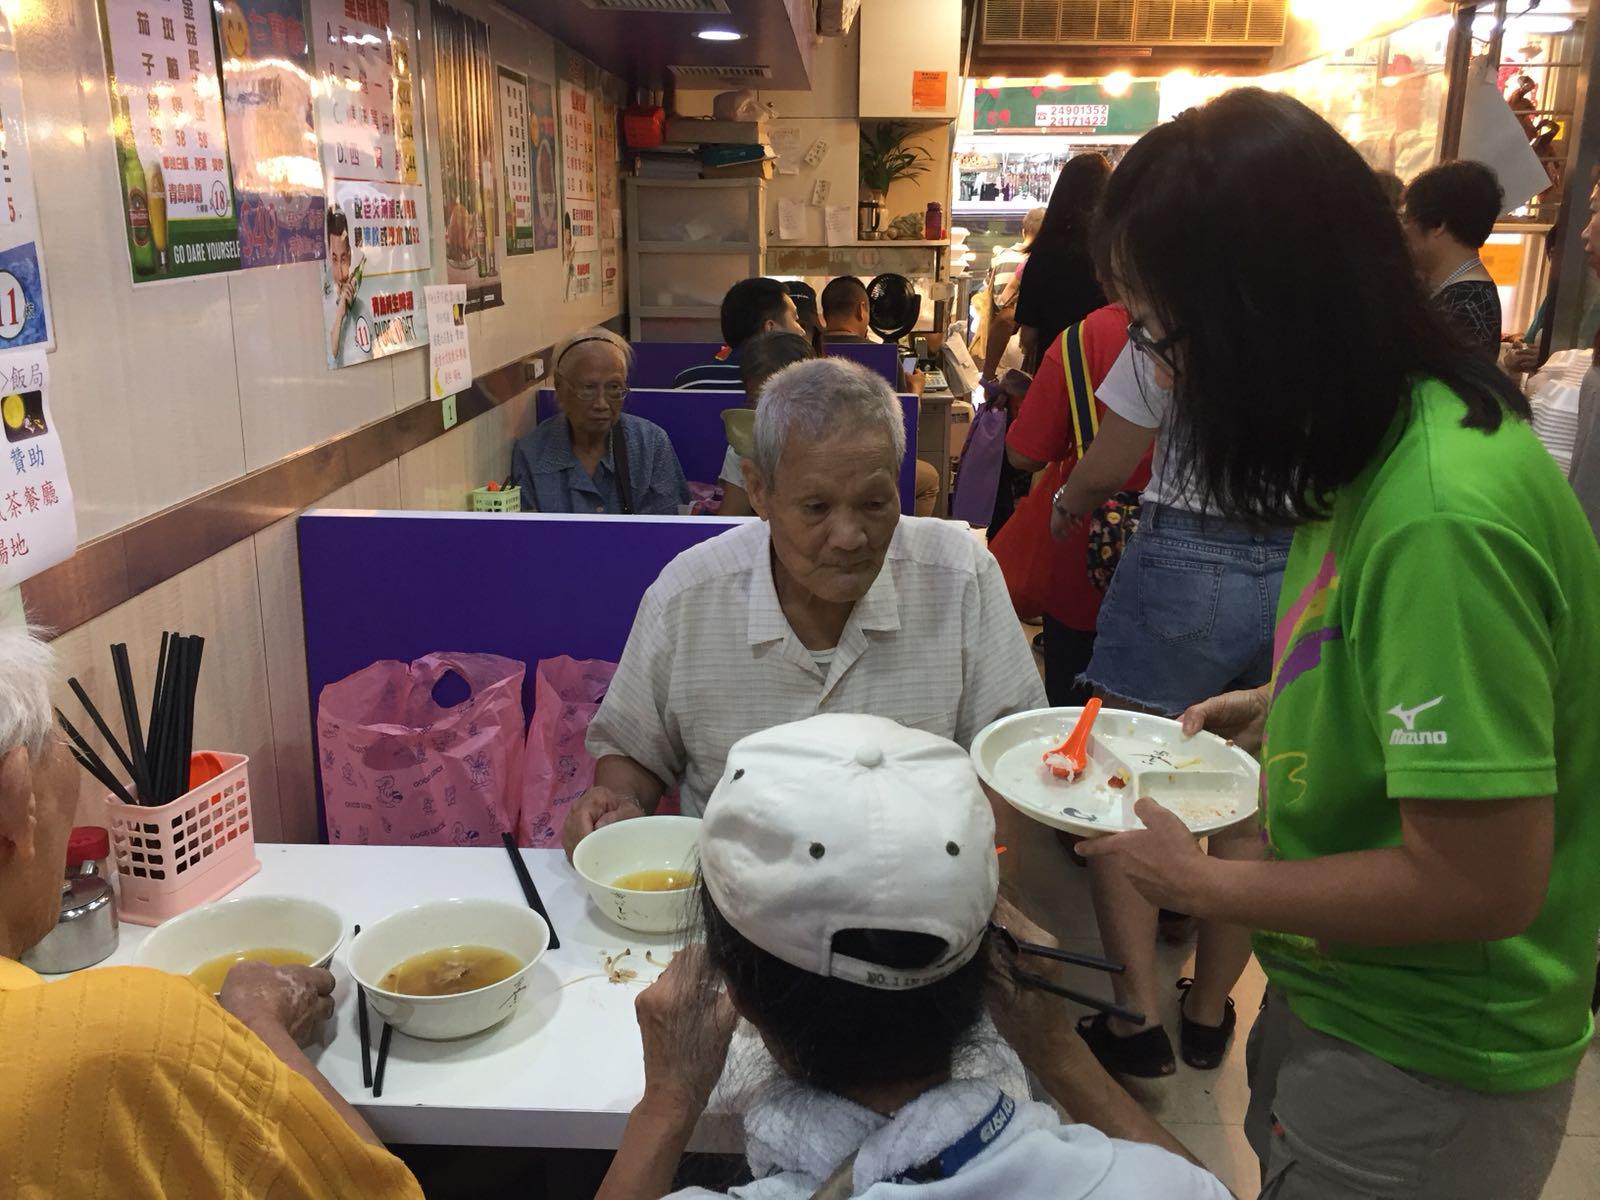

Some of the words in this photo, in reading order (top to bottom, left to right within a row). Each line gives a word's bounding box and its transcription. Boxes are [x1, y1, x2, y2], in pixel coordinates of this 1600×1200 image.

[1050, 105, 1107, 115] 24901352
[1050, 116, 1107, 126] 24171422
[214, 190, 226, 211] 18
[173, 244, 186, 265] GO
[186, 242, 206, 263] DARE
[206, 239, 241, 262] YOURSELF
[0, 480, 60, 522] 茶餐廳
